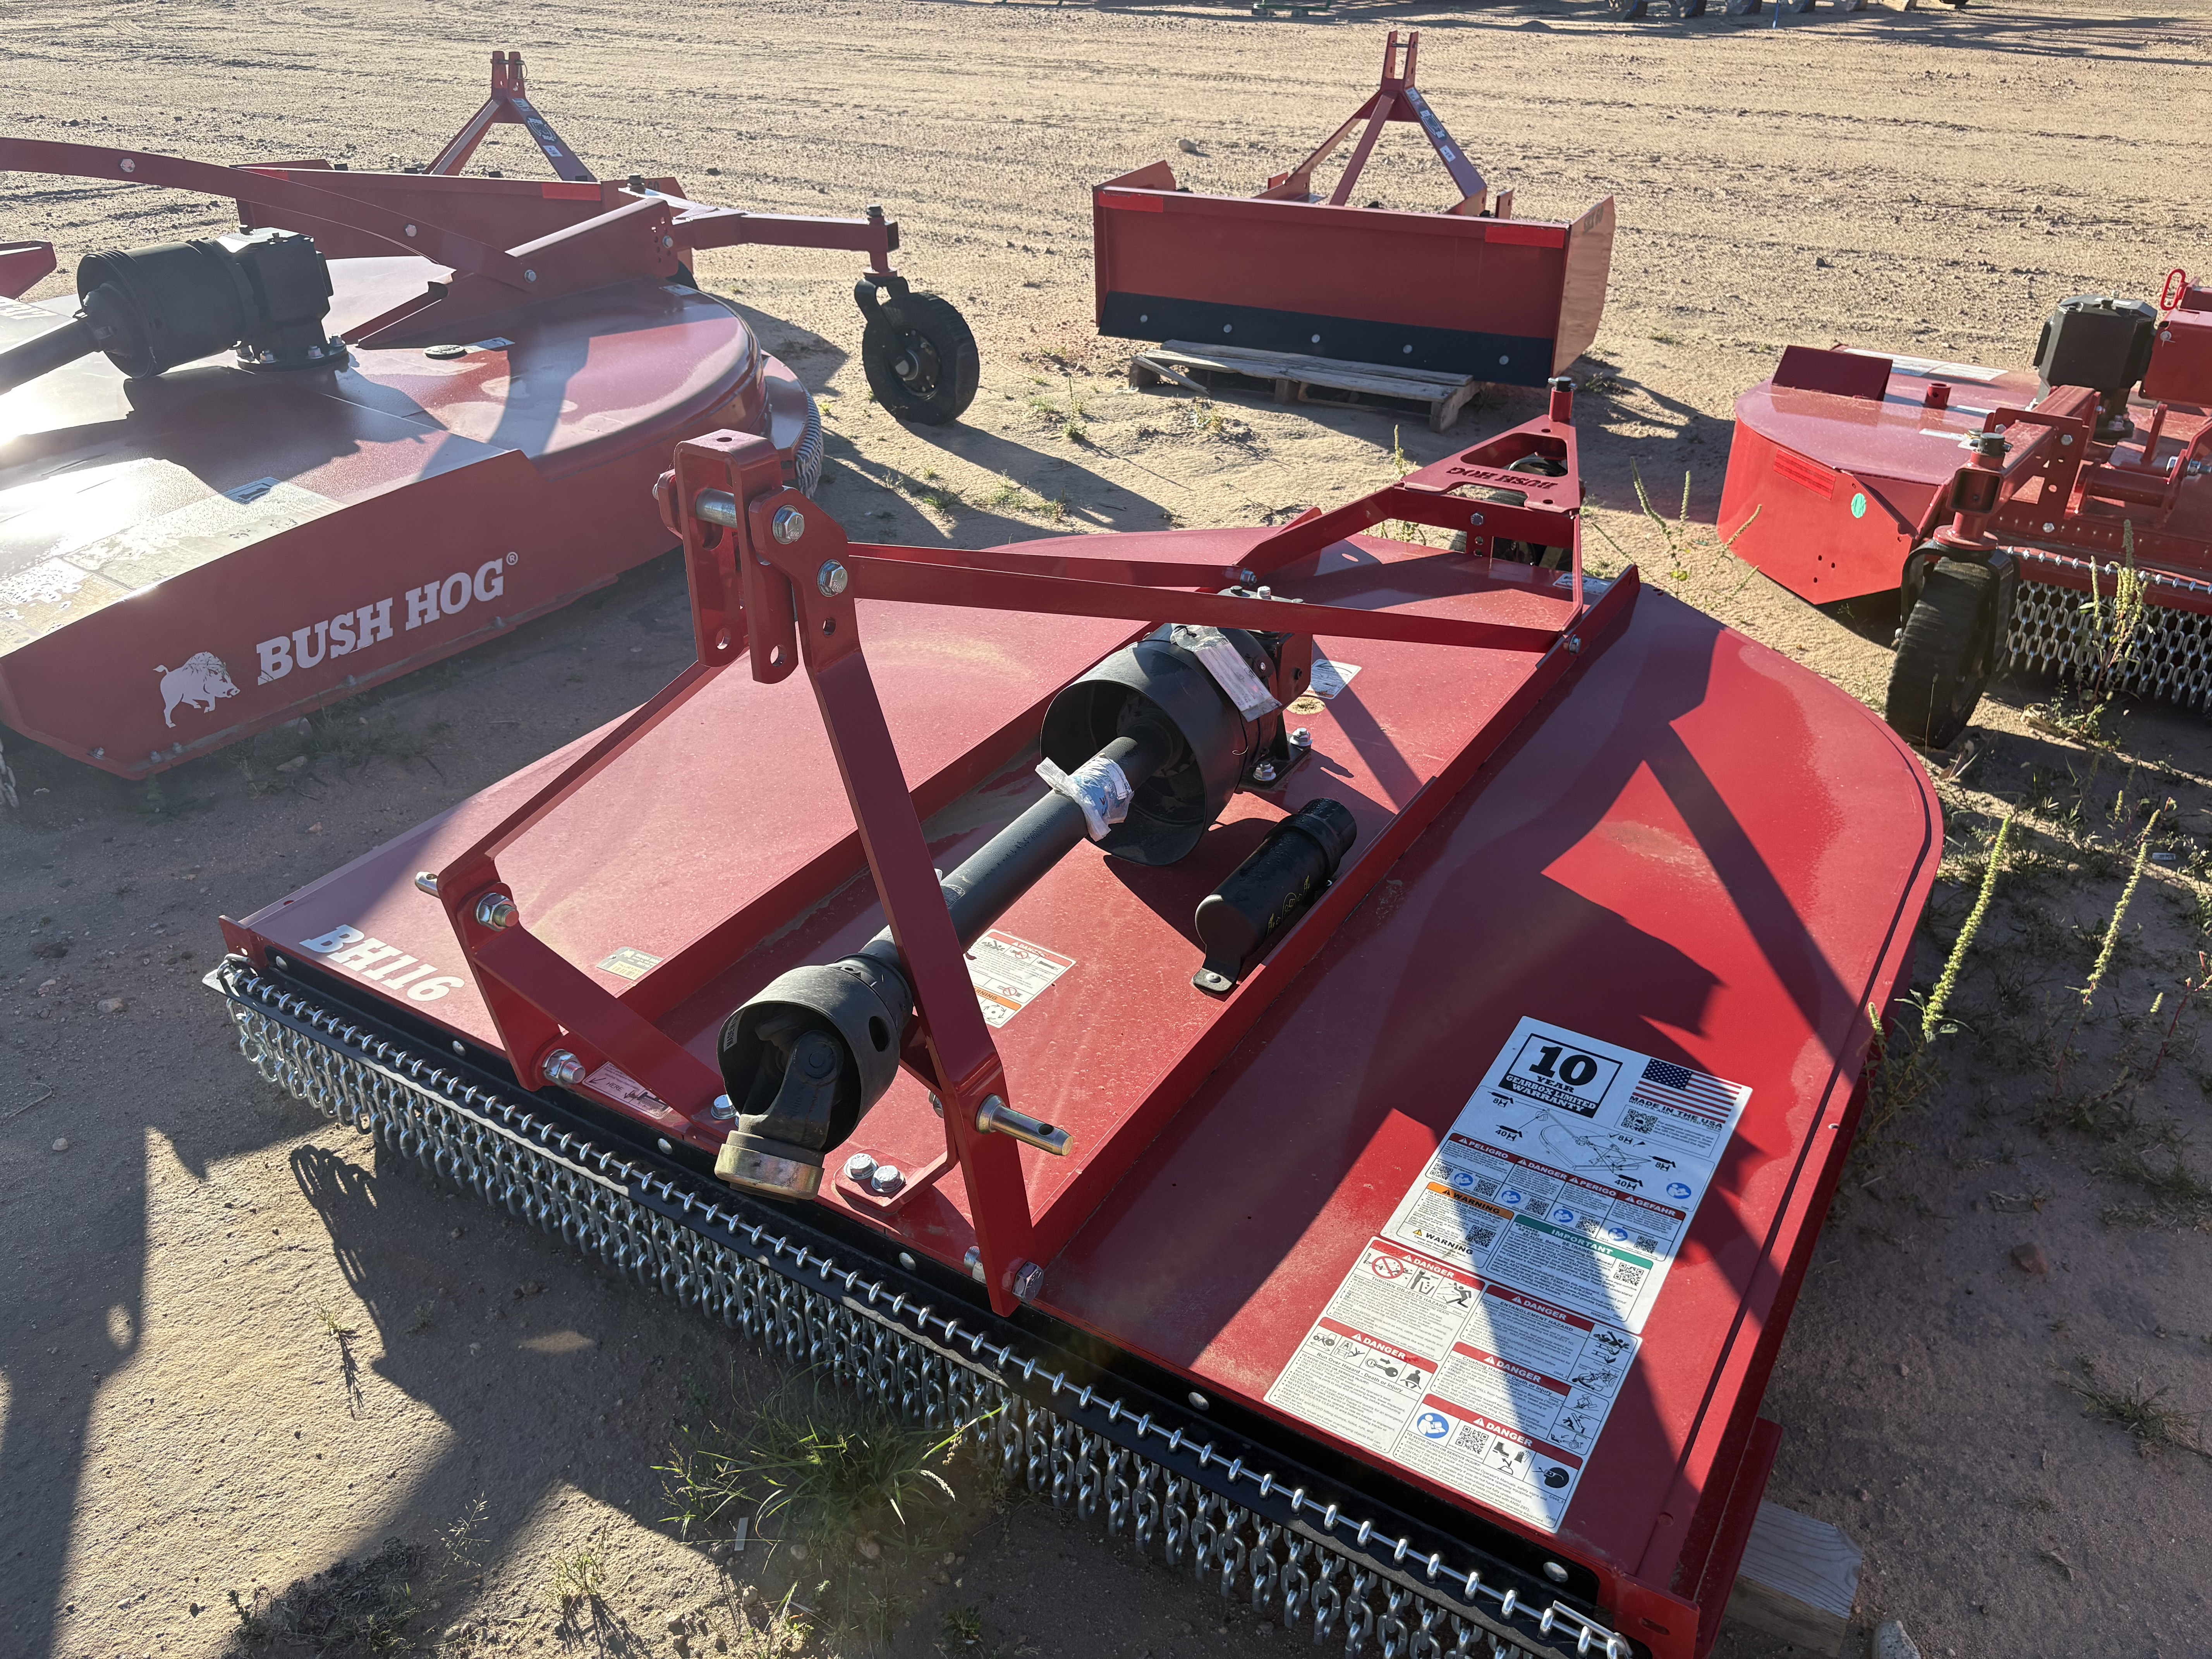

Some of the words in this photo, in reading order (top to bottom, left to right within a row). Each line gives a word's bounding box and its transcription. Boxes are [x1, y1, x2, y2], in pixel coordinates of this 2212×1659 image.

[1446, 467, 1498, 480] HOG
[1494, 475, 1558, 489] BUSH
[256, 598, 393, 686] BUSH
[299, 924, 465, 1001] BH116
[974, 988, 998, 1001] RNING
[1529, 1045, 1598, 1086] 10
[605, 1082, 624, 1092] HERE
[1504, 1075, 1555, 1096] GEARBOX
[1553, 1091, 1597, 1109] LIMITED
[1535, 1075, 1575, 1093] YEAR
[1510, 1084, 1585, 1113] WARRANTY
[1629, 1096, 1660, 1109] MADE
[1676, 1110, 1698, 1121] THE
[1700, 1118, 1723, 1128] USA
[1494, 1128, 1508, 1138] 40
[1468, 1141, 1509, 1159] PELIGRO
[1527, 1162, 1568, 1180] DANGER
[1579, 1180, 1617, 1197] PERIGO
[1613, 1178, 1628, 1188] 40
[1452, 1193, 1501, 1214] WARNING
[1469, 1206, 1487, 1215] SERIOUS
[1635, 1199, 1676, 1216] GEFAHR
[1425, 1233, 1474, 1255] WARNING
[1551, 1229, 1613, 1255] IMPORTANT
[1570, 1244, 1594, 1255] TRAINED
[1545, 1240, 1561, 1248] Before
[1561, 1246, 1585, 1257] Operating
[1596, 1258, 1613, 1266] Mower
[1413, 1259, 1455, 1278] DANGER
[1371, 1276, 1396, 1289] THROWN
[1396, 1286, 1423, 1300] OBJECTS
[1423, 1297, 1448, 1309] HAZARD
[1499, 1301, 1547, 1322] ENTANGLEMENT
[1548, 1320, 1573, 1332] HAZARD
[1523, 1300, 1567, 1321] DANGER
[1362, 1337, 1407, 1360] DANGER
[1328, 1357, 1341, 1365] Over
[1341, 1363, 1360, 1374] Hazard
[1364, 1373, 1380, 1382] Death
[1386, 1383, 1403, 1393] Injury
[1462, 1356, 1487, 1370] Crushing
[1488, 1366, 1508, 1377] Hazard
[1511, 1376, 1528, 1386] Death
[1535, 1386, 1553, 1396] Injury
[1496, 1360, 1542, 1382] DANGER
[1485, 1422, 1534, 1447] DANGER
